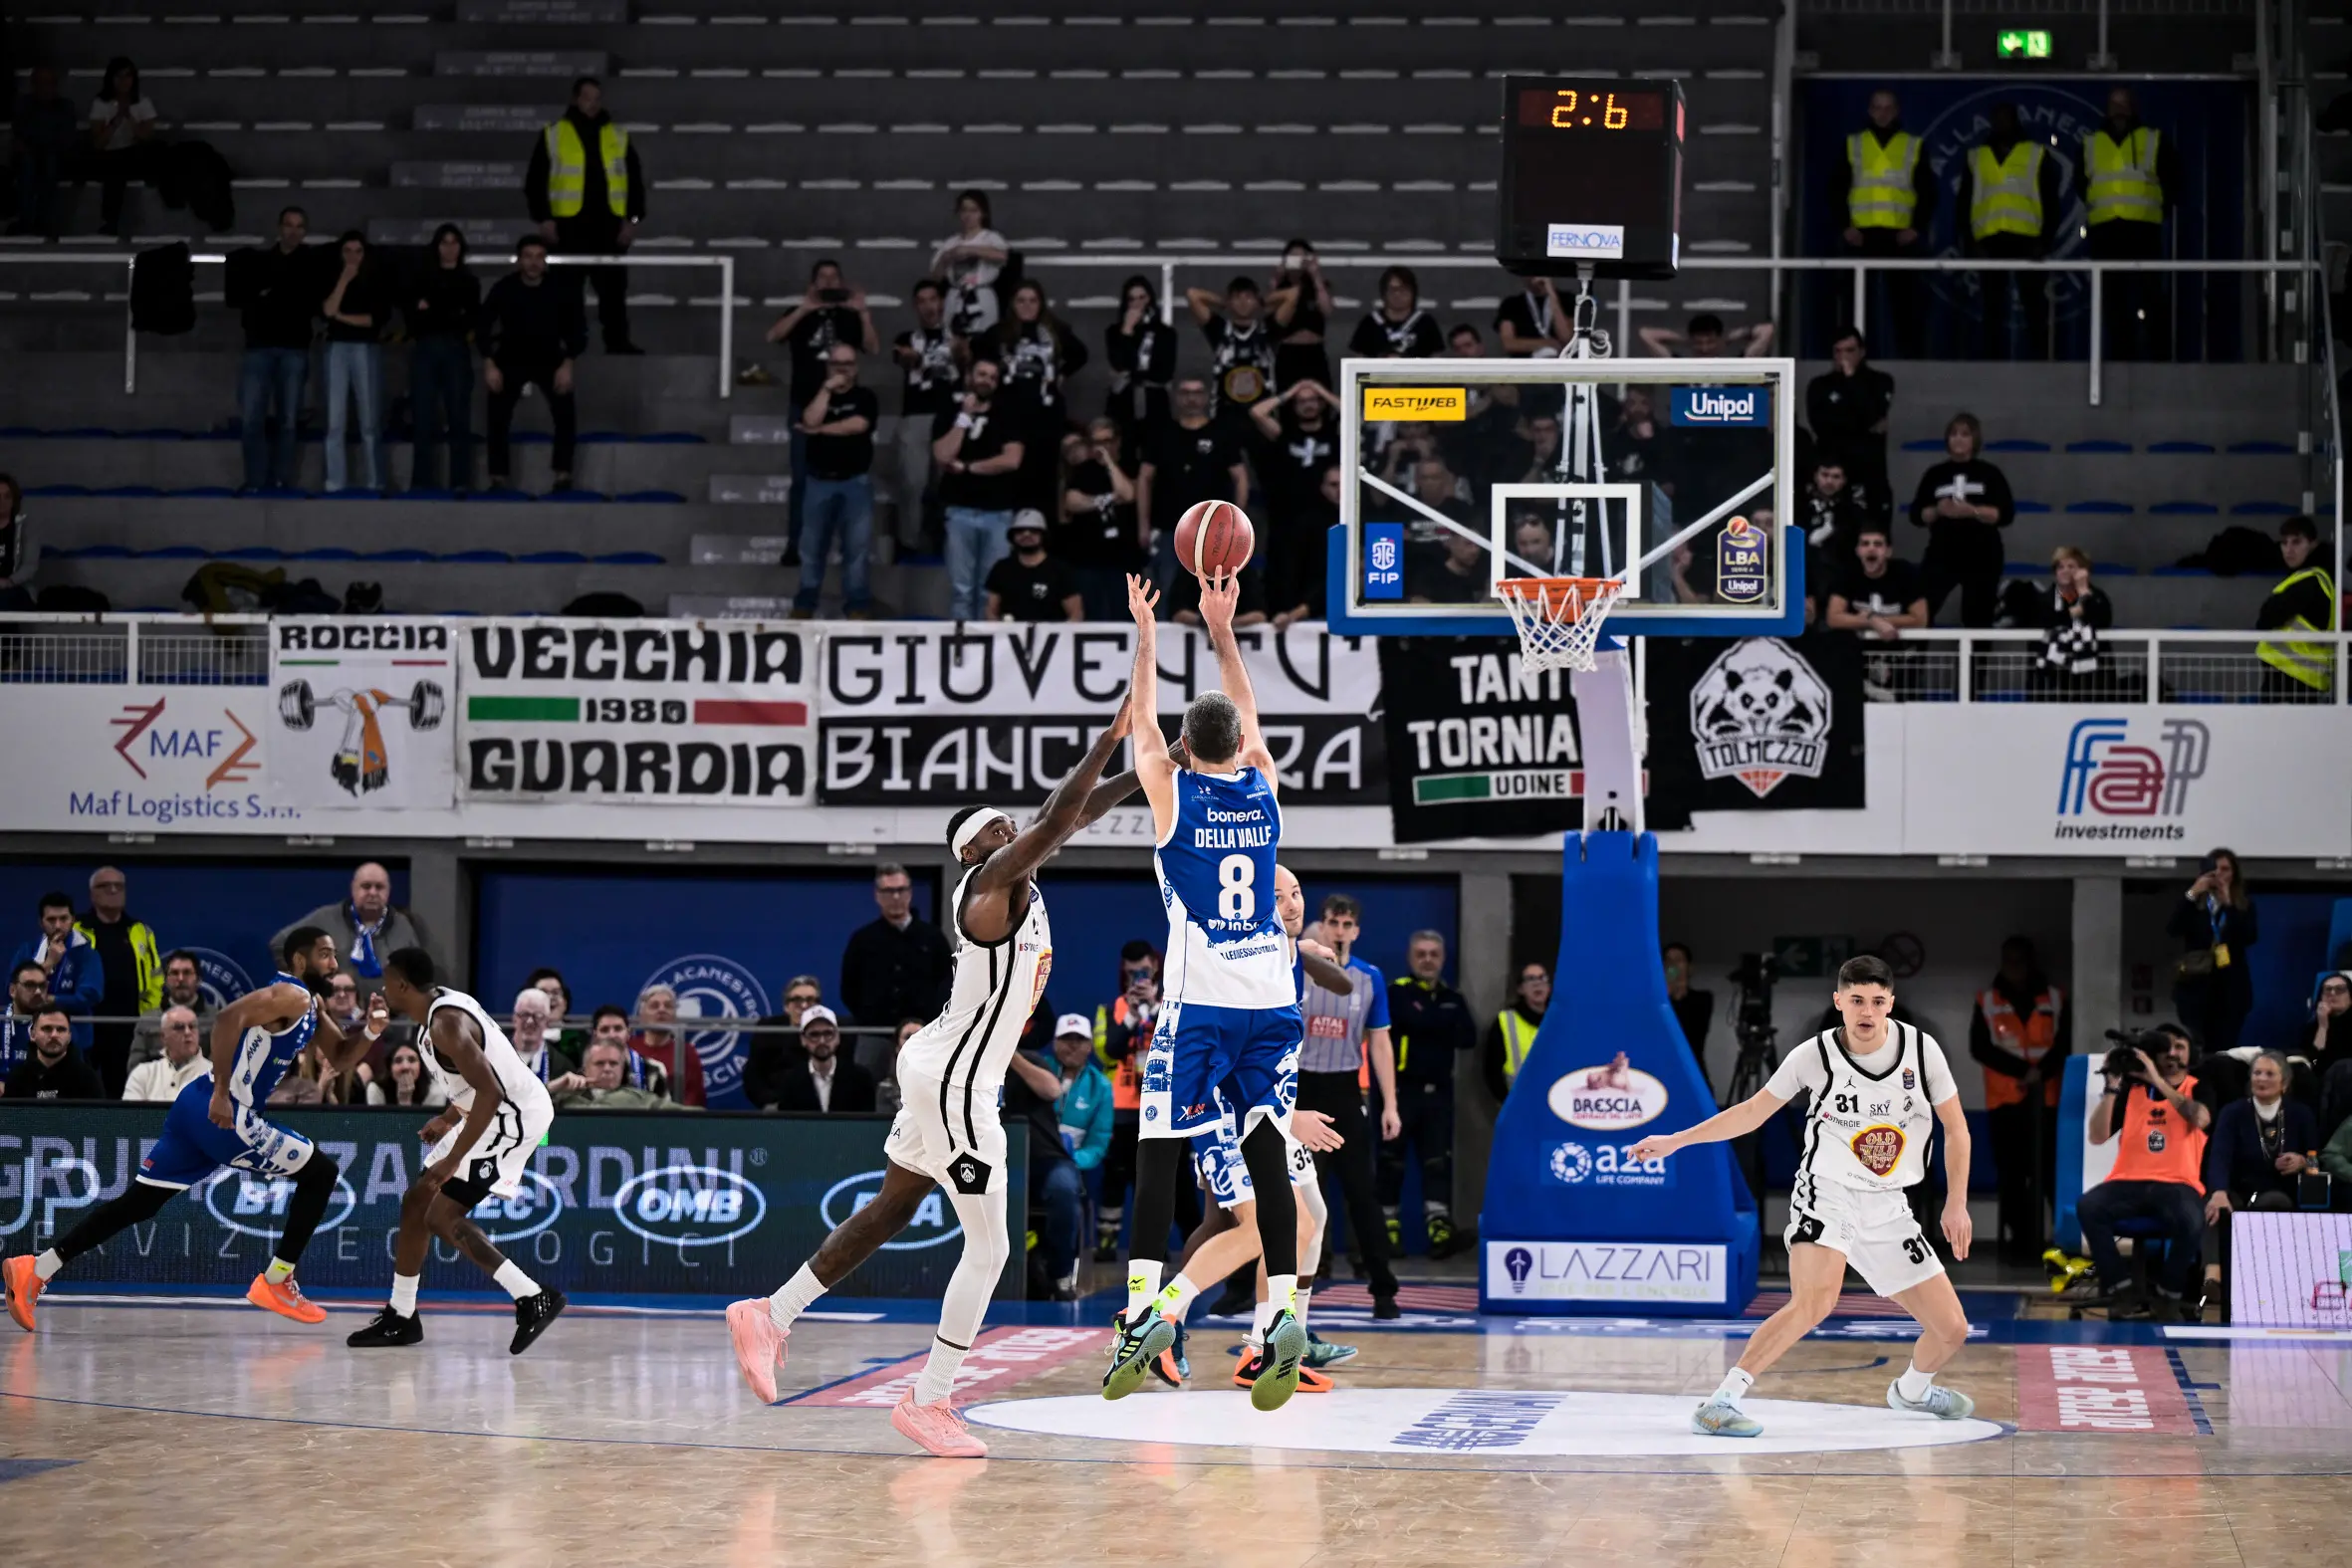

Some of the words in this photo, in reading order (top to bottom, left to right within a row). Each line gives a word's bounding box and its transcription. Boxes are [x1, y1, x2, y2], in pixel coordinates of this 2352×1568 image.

[1550, 232, 1621, 249] FERNOVA
[1373, 397, 1457, 411] FASTWEB
[1691, 392, 1754, 421] Unipol
[1725, 552, 1761, 565] LBA
[1368, 572, 1399, 584] FIP
[1728, 579, 1759, 593] Unipol
[279, 625, 448, 650] ROCCIA
[472, 626, 804, 685] VECCHIA
[586, 699, 687, 724] 1980
[149, 730, 222, 758] MAF
[1706, 740, 1817, 768] TOLMEZZO
[469, 738, 808, 797] GUARDIA
[825, 726, 1362, 790] BIANCRA
[1496, 774, 1566, 795] UDINE
[70, 792, 122, 816] Maf
[127, 794, 239, 824] Logistics
[1207, 807, 1265, 823] bonera.
[1195, 828, 1236, 848] DELLA
[2054, 821, 2185, 841] investments
[1219, 853, 1255, 920] 8
[701, 1054, 749, 1087] SCIA
[1573, 1098, 1642, 1113] BRESCIA
[1835, 1094, 1859, 1113] 31
[1869, 1103, 1891, 1114] SKY
[1828, 1115, 1861, 1128] SYNERGIE
[1865, 1131, 1896, 1146] OLD
[1859, 1144, 1896, 1156] WILD
[1860, 1155, 1894, 1169] WEST
[1596, 1175, 1615, 1185] LIFE
[1616, 1176, 1666, 1186] COMPANY
[637, 1188, 744, 1223] OMB
[1902, 1232, 1933, 1265] 31
[1539, 1246, 1711, 1282] LAZZARI
